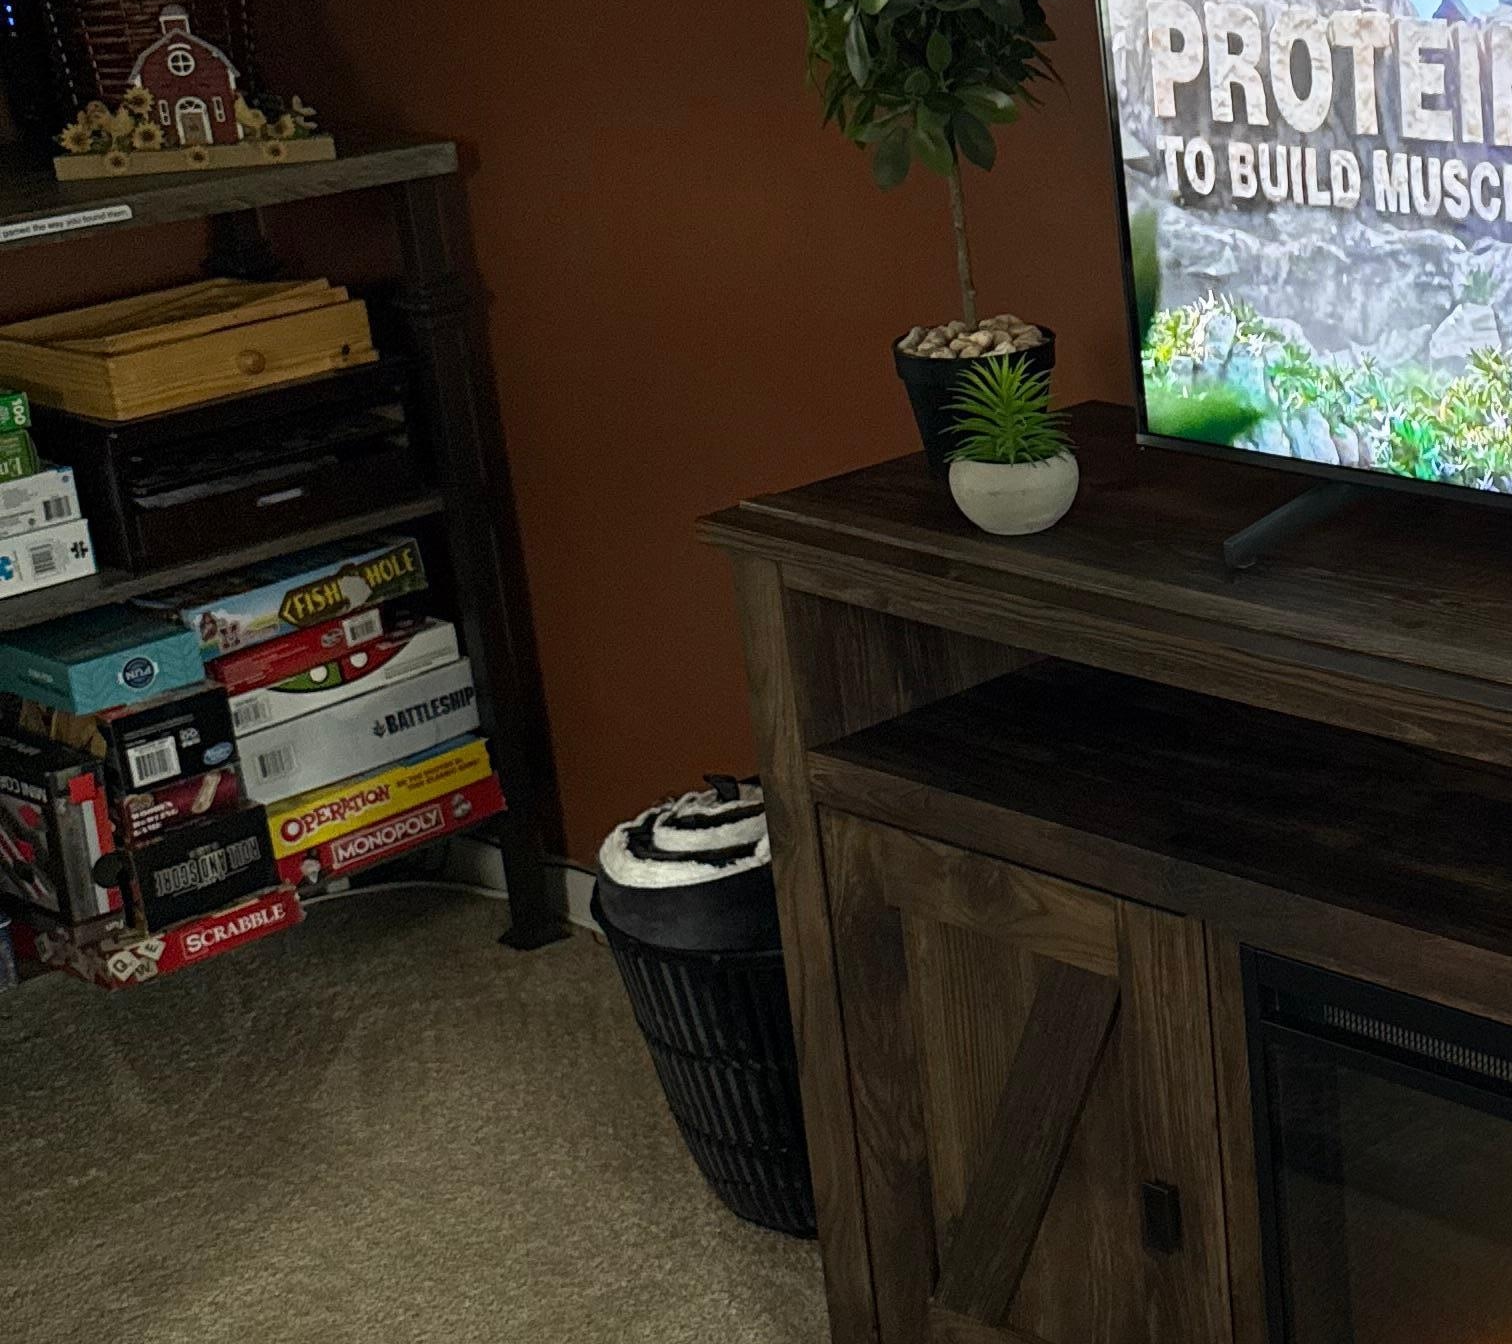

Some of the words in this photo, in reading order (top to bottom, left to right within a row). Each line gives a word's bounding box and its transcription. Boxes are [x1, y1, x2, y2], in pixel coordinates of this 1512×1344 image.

[1156, 135, 1216, 196] TO
[1228, 142, 1361, 209] BUILD
[12, 398, 27, 426] 100
[365, 547, 414, 590] HOLE
[384, 685, 475, 736] BATTLESHIP
[280, 782, 391, 843] OPERATION
[337, 808, 438, 863] MONOPOLY
[185, 902, 287, 953] SCRABBLE
